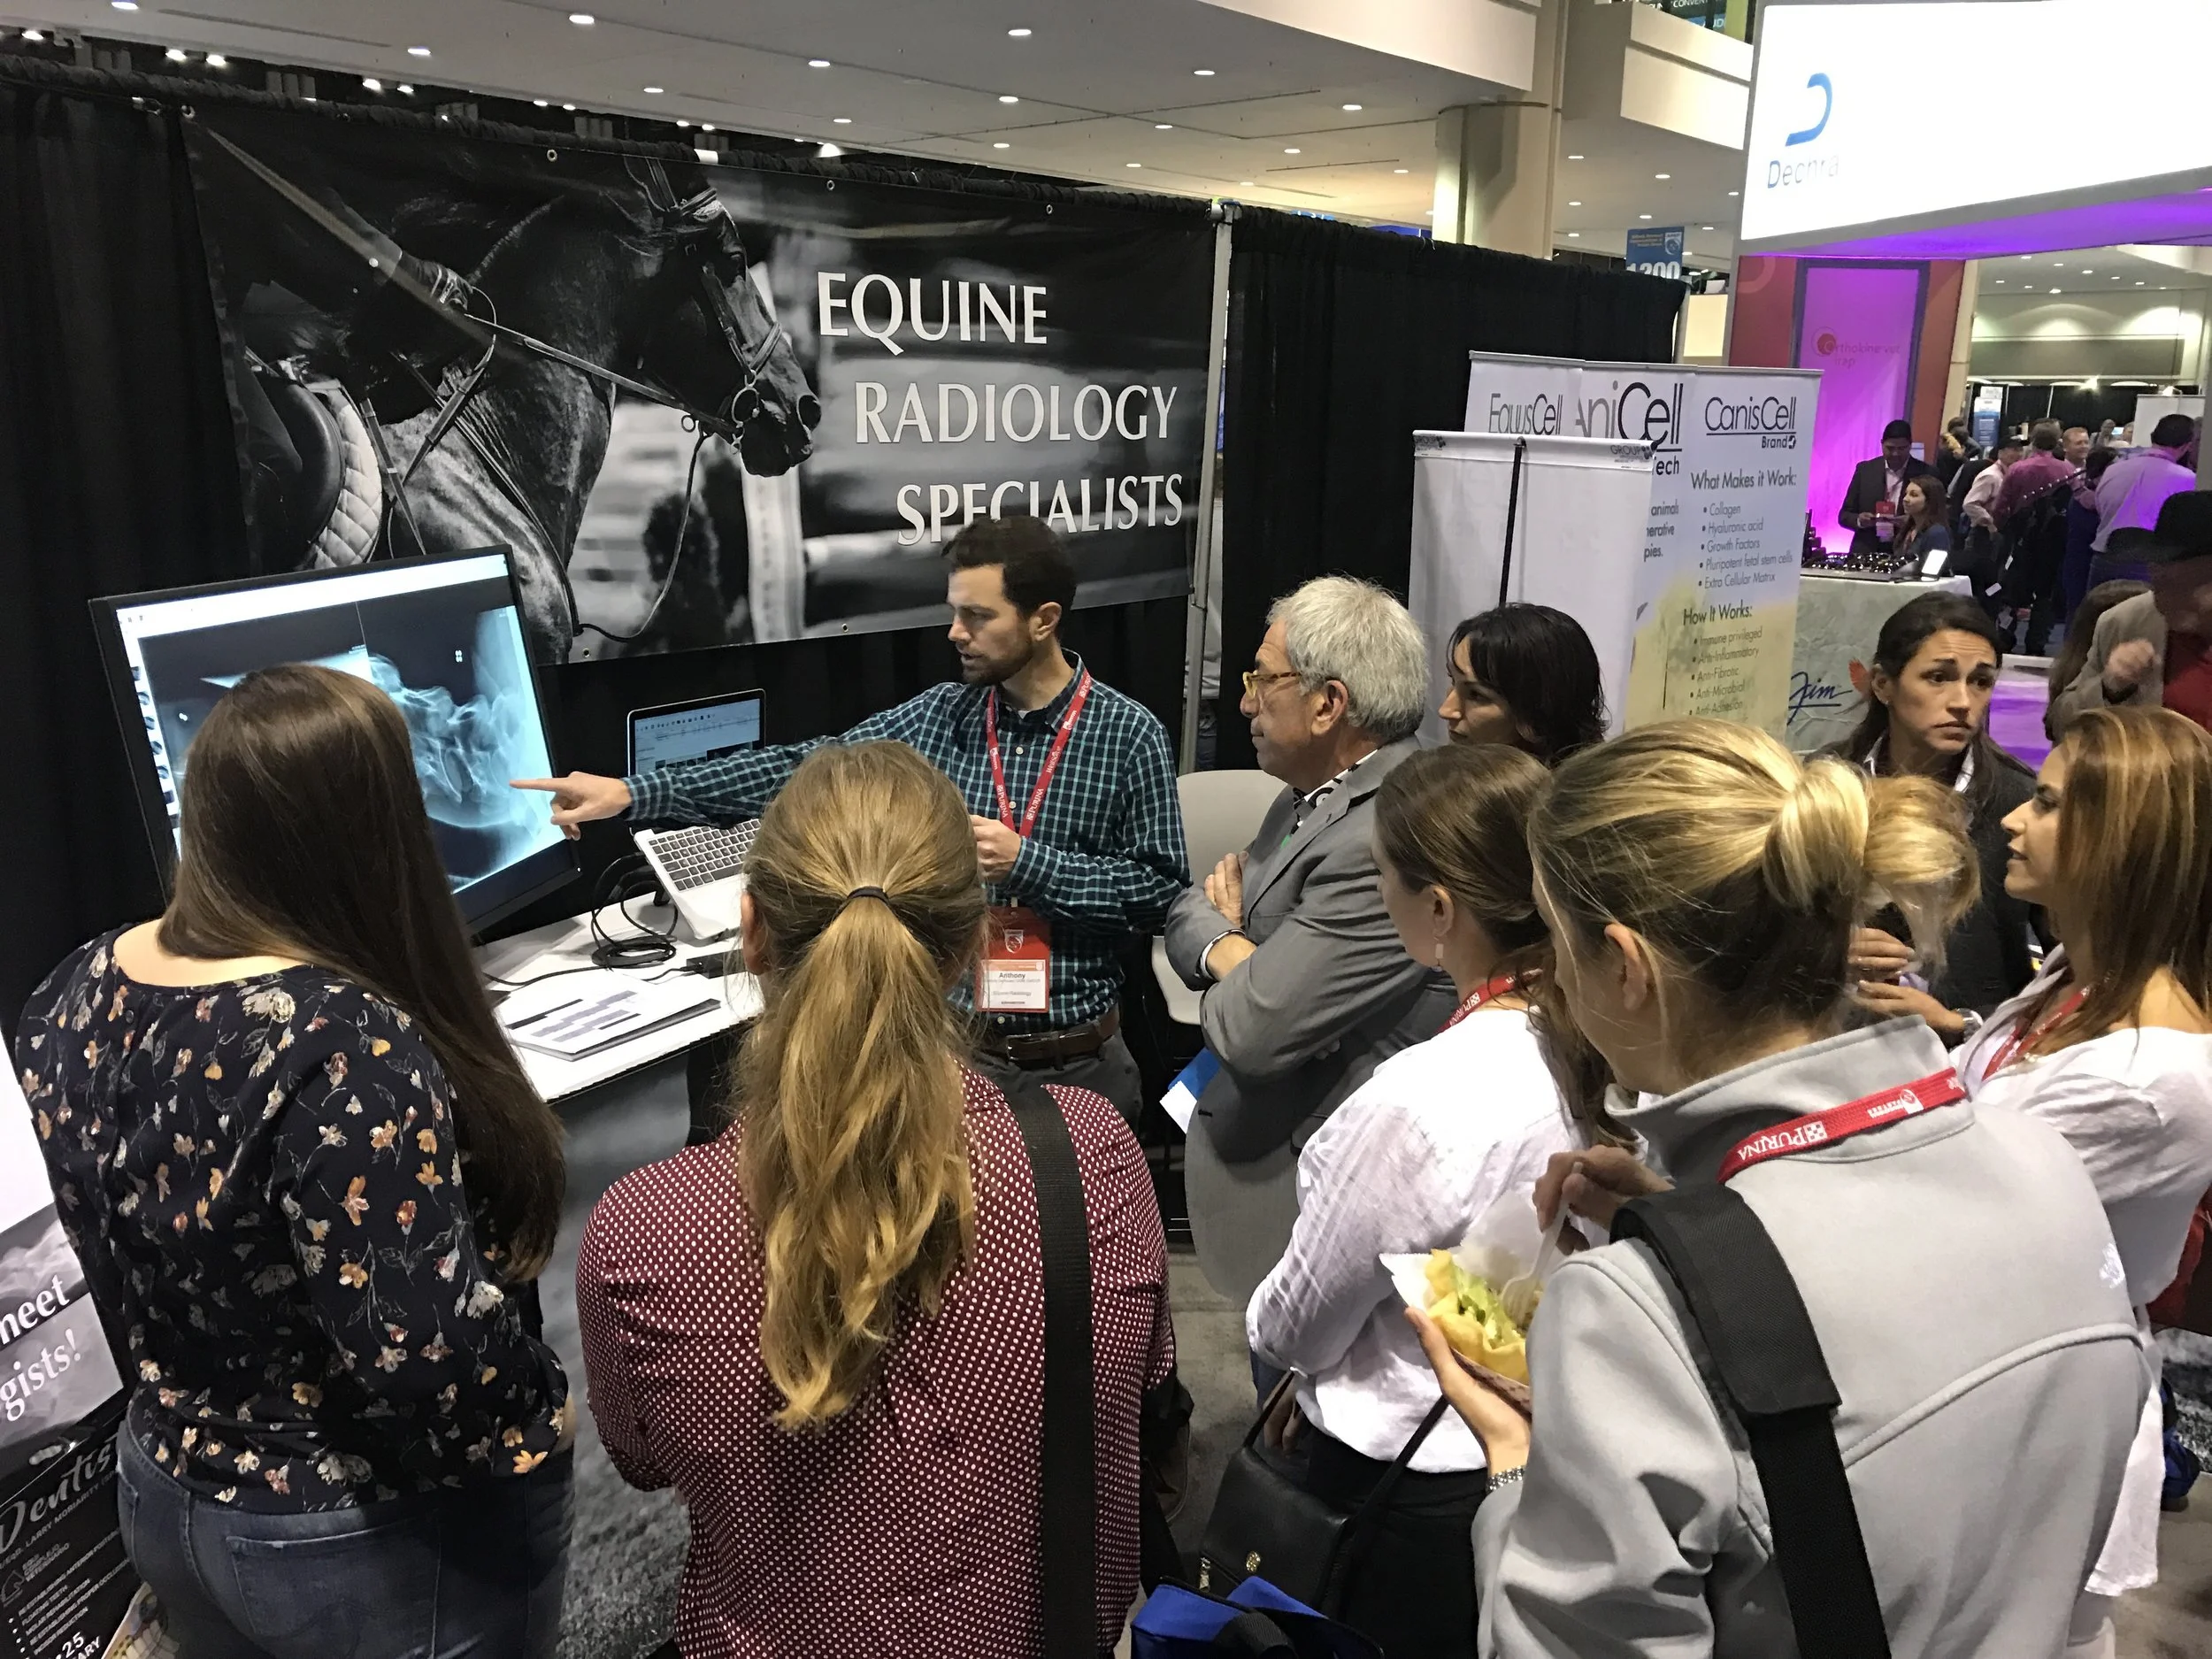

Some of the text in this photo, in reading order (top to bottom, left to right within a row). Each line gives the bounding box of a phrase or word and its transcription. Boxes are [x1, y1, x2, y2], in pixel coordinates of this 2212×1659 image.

[1768, 155, 1839, 188] Dechra
[818, 271, 1048, 356] EQUINE
[855, 380, 1178, 443] RADIOLOGY
[1705, 396, 1797, 432] CanisCell
[1761, 434, 1788, 449] Brand
[1653, 455, 1680, 476] ech
[1691, 466, 1797, 489] What Makes it Work:
[895, 473, 1183, 546] SPECIALISTS
[1709, 502, 1740, 518] Collagen
[1708, 517, 1764, 537] Hyaluronic acid
[1707, 537, 1761, 552] Growth Factors
[1706, 549, 1793, 573] Pluripotent fetal stem cells
[1704, 572, 1776, 589] Extra Cellular Matrix
[1683, 599, 1753, 626] How It Works:
[1728, 626, 1763, 646] privileged
[1029, 787, 1044, 815] PURINA
[1737, 1127, 1807, 1161] PURINA
[0, 1432, 118, 1555] Dentis
[25, 1521, 53, 1547] LARRY
[73, 1636, 100, 1659] ARY
